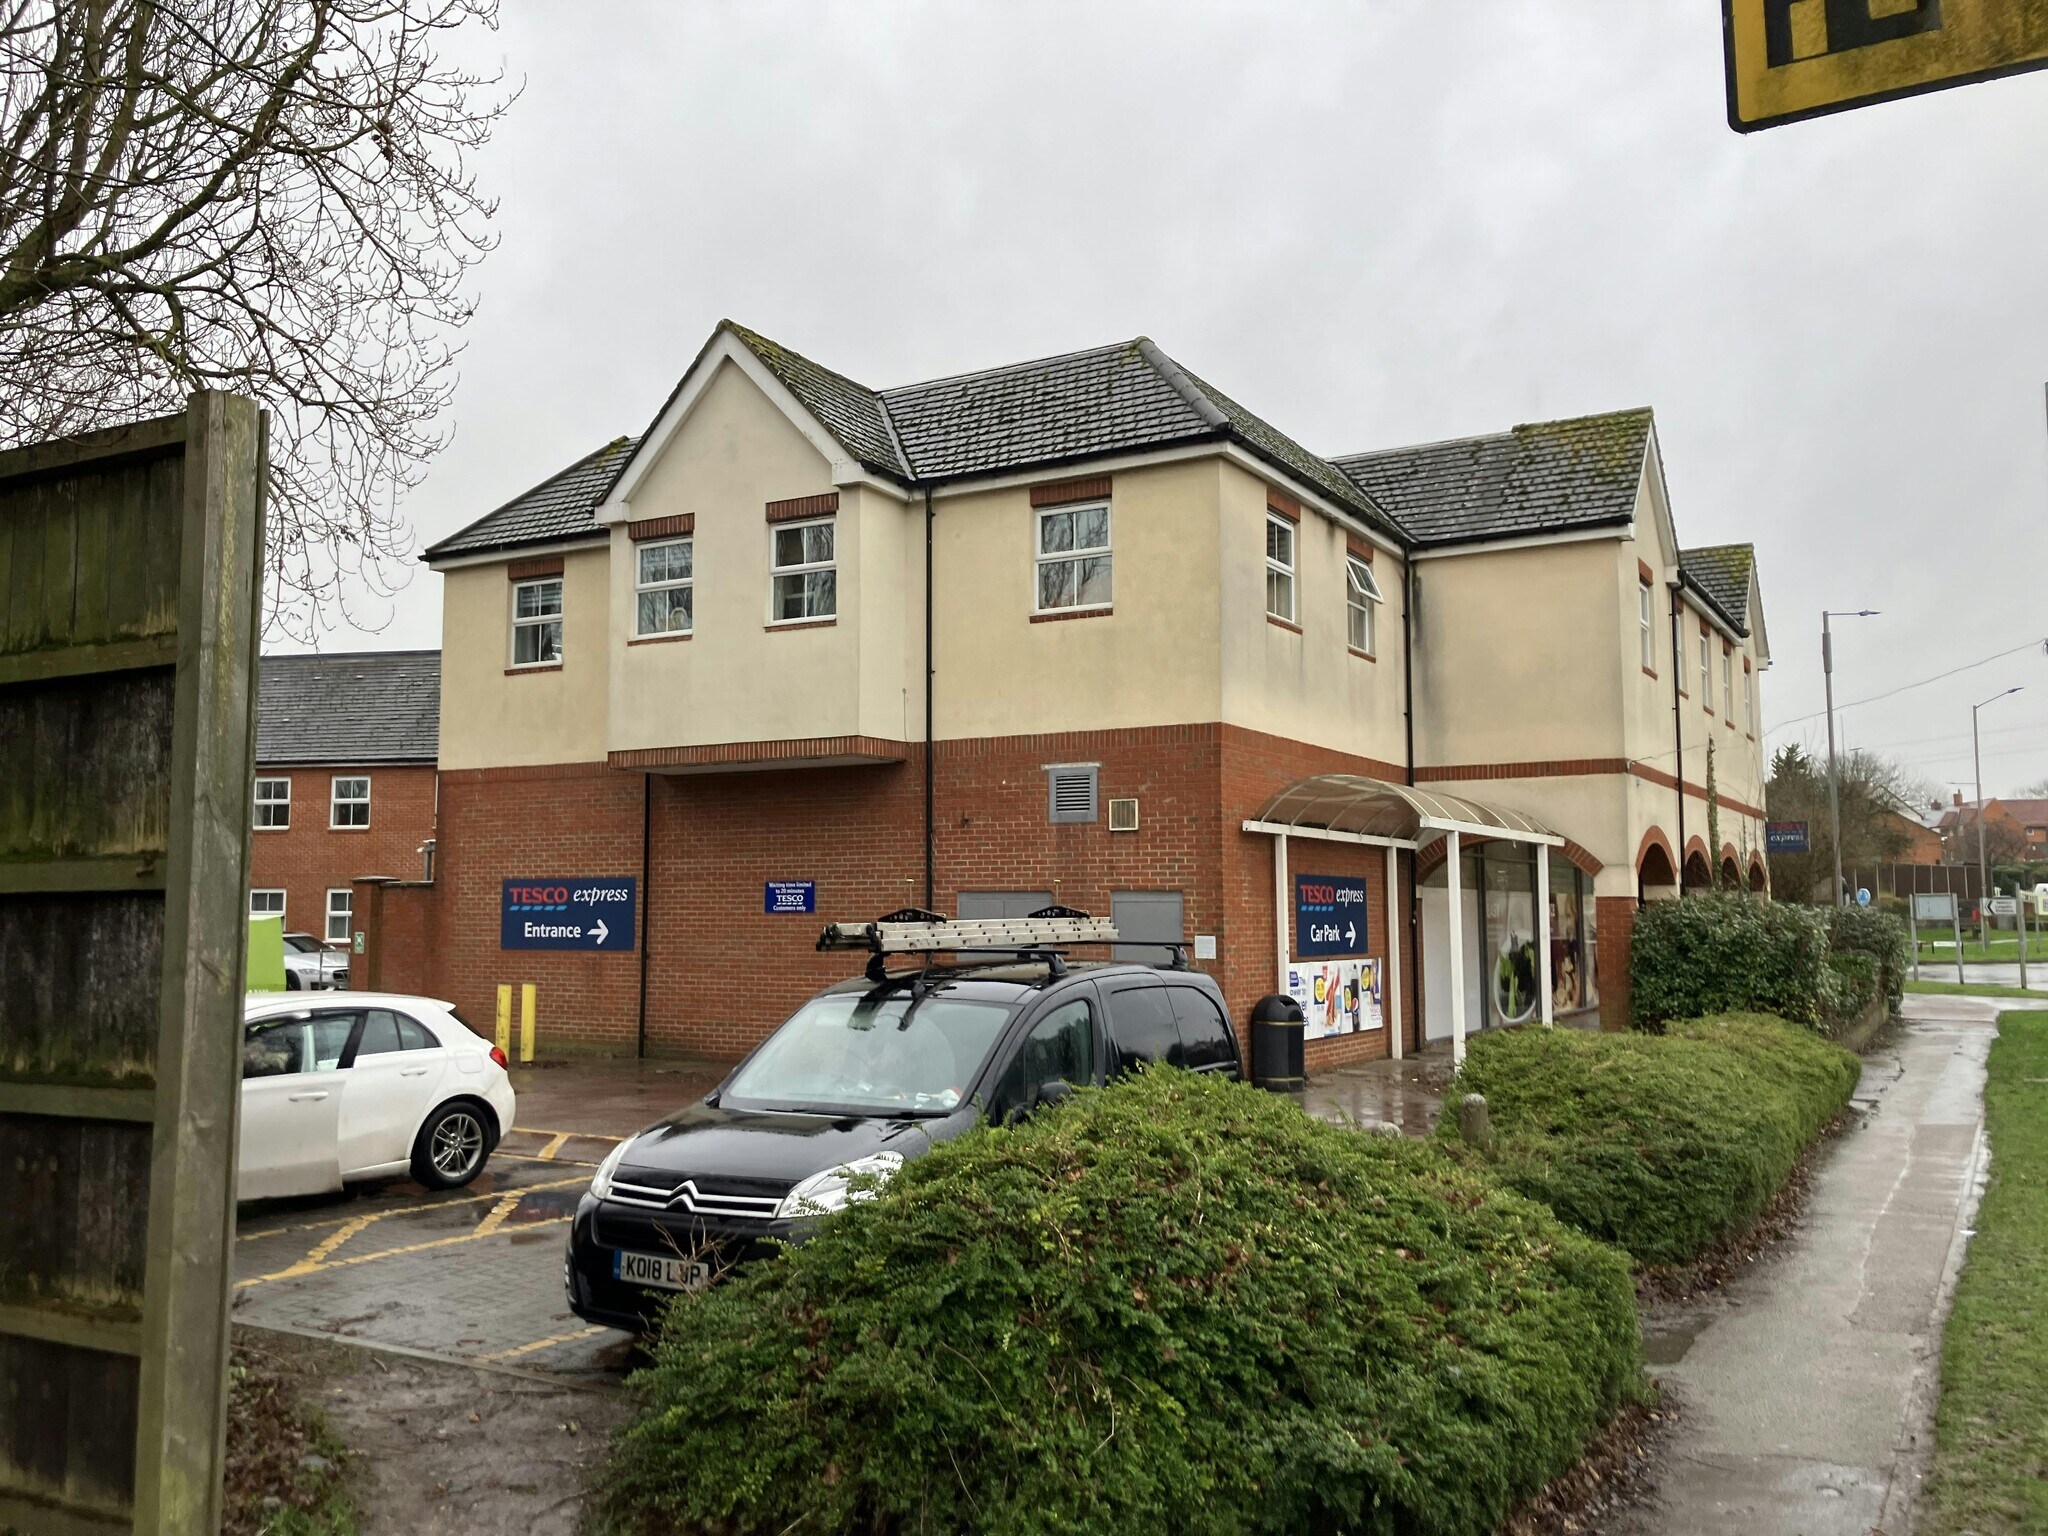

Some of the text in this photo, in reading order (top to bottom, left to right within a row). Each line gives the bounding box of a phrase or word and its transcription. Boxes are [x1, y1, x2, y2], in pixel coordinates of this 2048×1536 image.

[509, 886, 629, 906] TESCO express
[776, 894, 804, 902] TESCO
[1300, 884, 1364, 907] TESCO express
[524, 922, 582, 938] Entrance
[1310, 924, 1340, 942] Car Park
[626, 1255, 662, 1281] KO18
